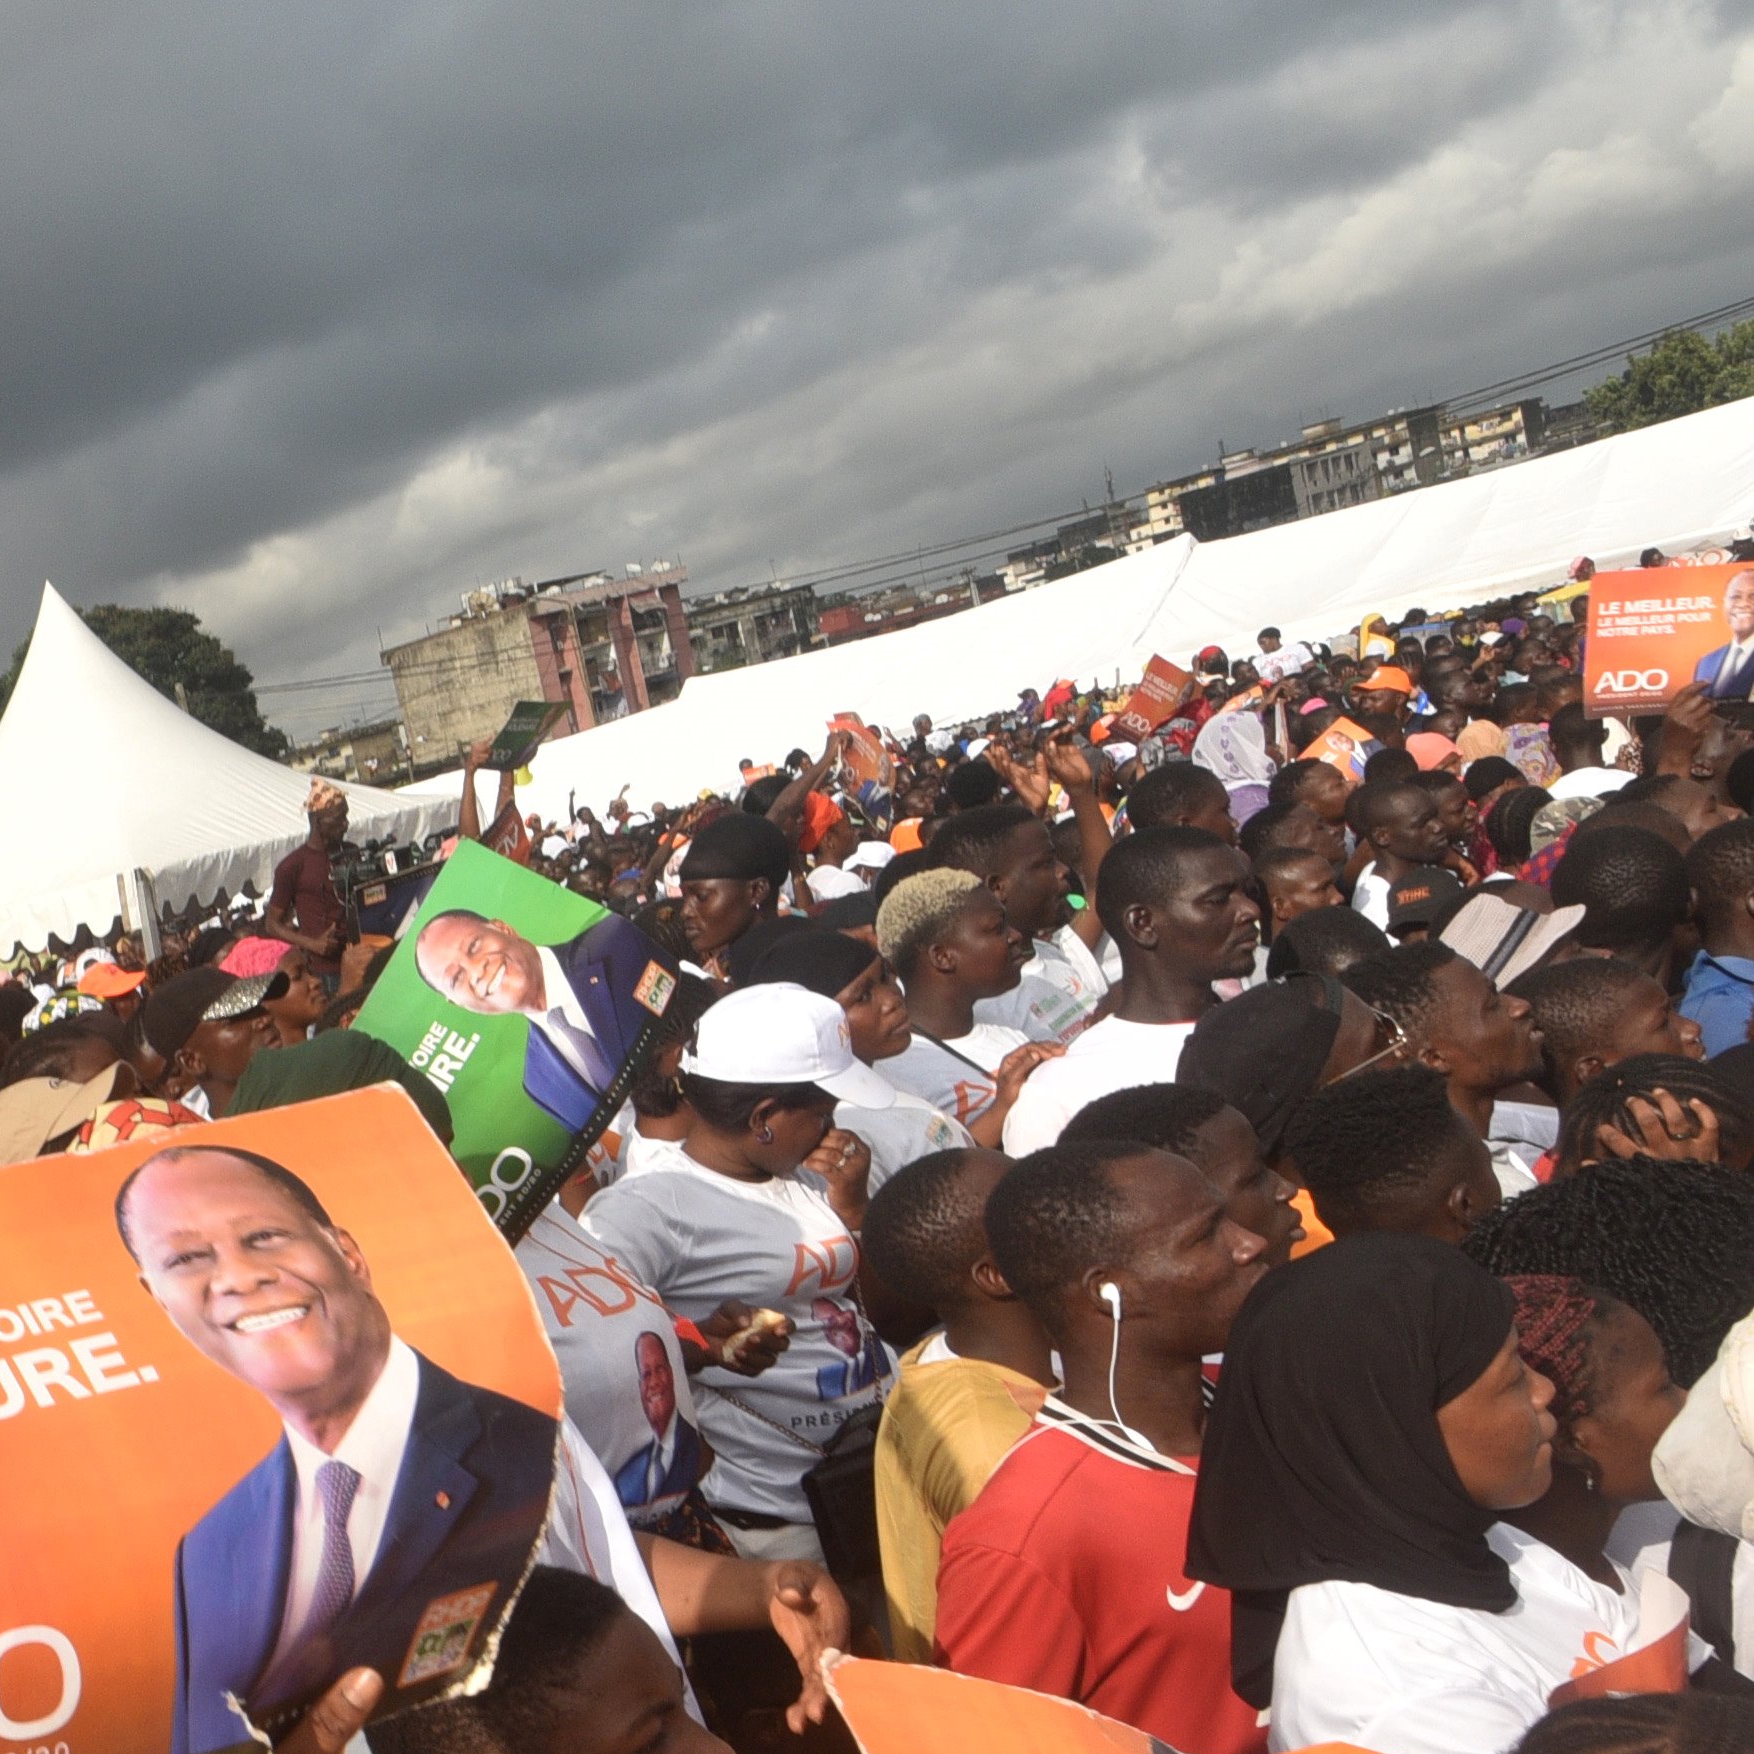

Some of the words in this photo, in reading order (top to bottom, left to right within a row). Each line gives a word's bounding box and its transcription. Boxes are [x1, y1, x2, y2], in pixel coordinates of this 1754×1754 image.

[1598, 602, 1620, 616] LE
[1624, 596, 1716, 614] MEILLEUR.
[1597, 614, 1614, 627] LE
[1615, 612, 1675, 627] MEILLEUR
[1677, 612, 1712, 623] POUR
[1597, 625, 1639, 637] NOTRE
[1642, 624, 1676, 637] PAYS.
[1594, 669, 1669, 693] ADO
[476, 1146, 532, 1221] DO
[784, 1235, 860, 1296] AD
